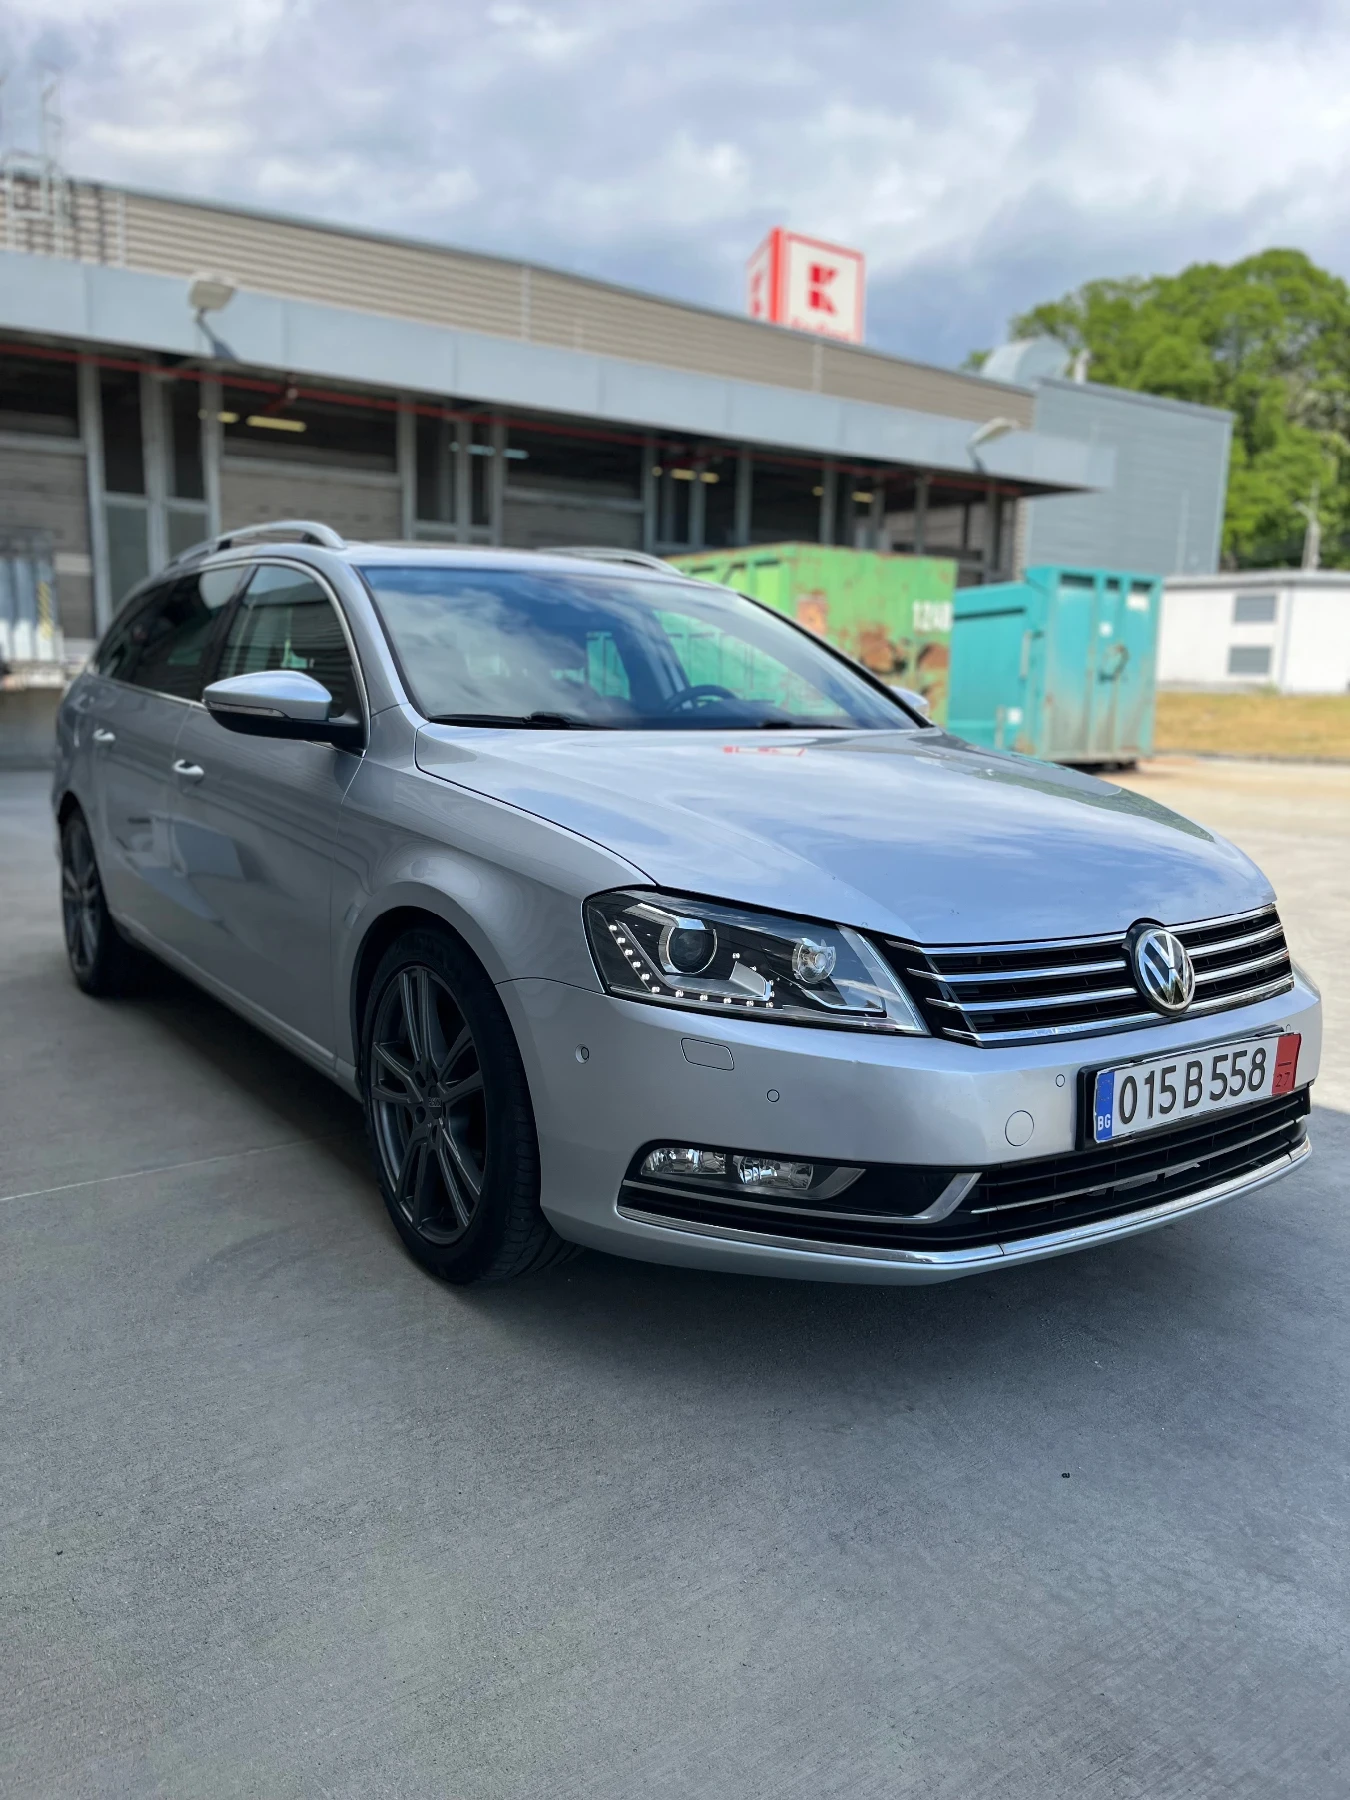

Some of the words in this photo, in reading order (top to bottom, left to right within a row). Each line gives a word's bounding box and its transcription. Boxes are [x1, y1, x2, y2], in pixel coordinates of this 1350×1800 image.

[809, 262, 838, 315] K
[1135, 929, 1195, 1010] VW
[1119, 1047, 1267, 1125] 015B558
[1097, 1114, 1112, 1132] BG
